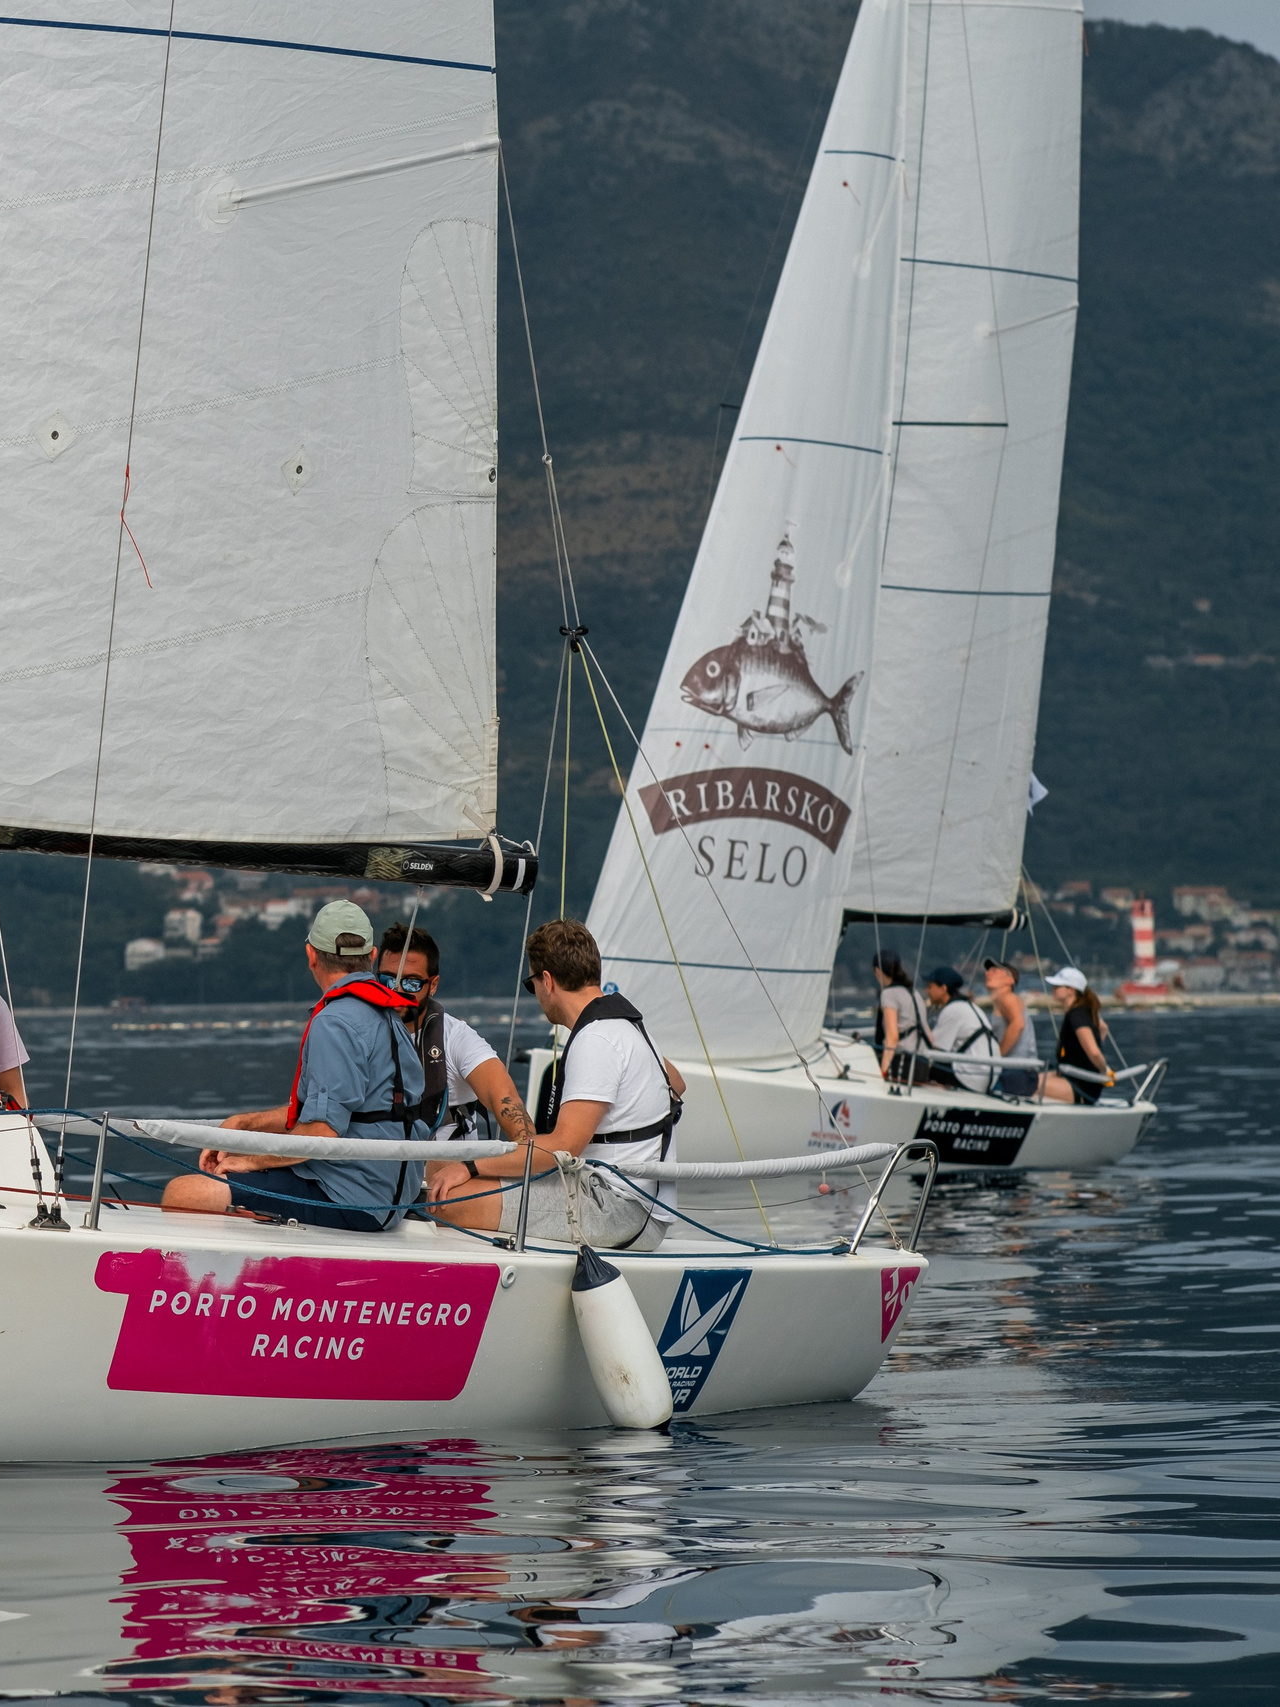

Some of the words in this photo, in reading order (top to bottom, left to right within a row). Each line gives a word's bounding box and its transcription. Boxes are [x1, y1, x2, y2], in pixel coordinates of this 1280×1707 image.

[666, 779, 835, 834] RIBARSKO
[694, 835, 808, 888] SELO
[923, 1120, 960, 1135] PORTO
[961, 1123, 1025, 1139] MONTENEGRO
[952, 1138, 990, 1151] RACING
[148, 1290, 257, 1319] PORTO
[271, 1297, 472, 1326] MONTENEGRO
[251, 1334, 366, 1361] RACING
